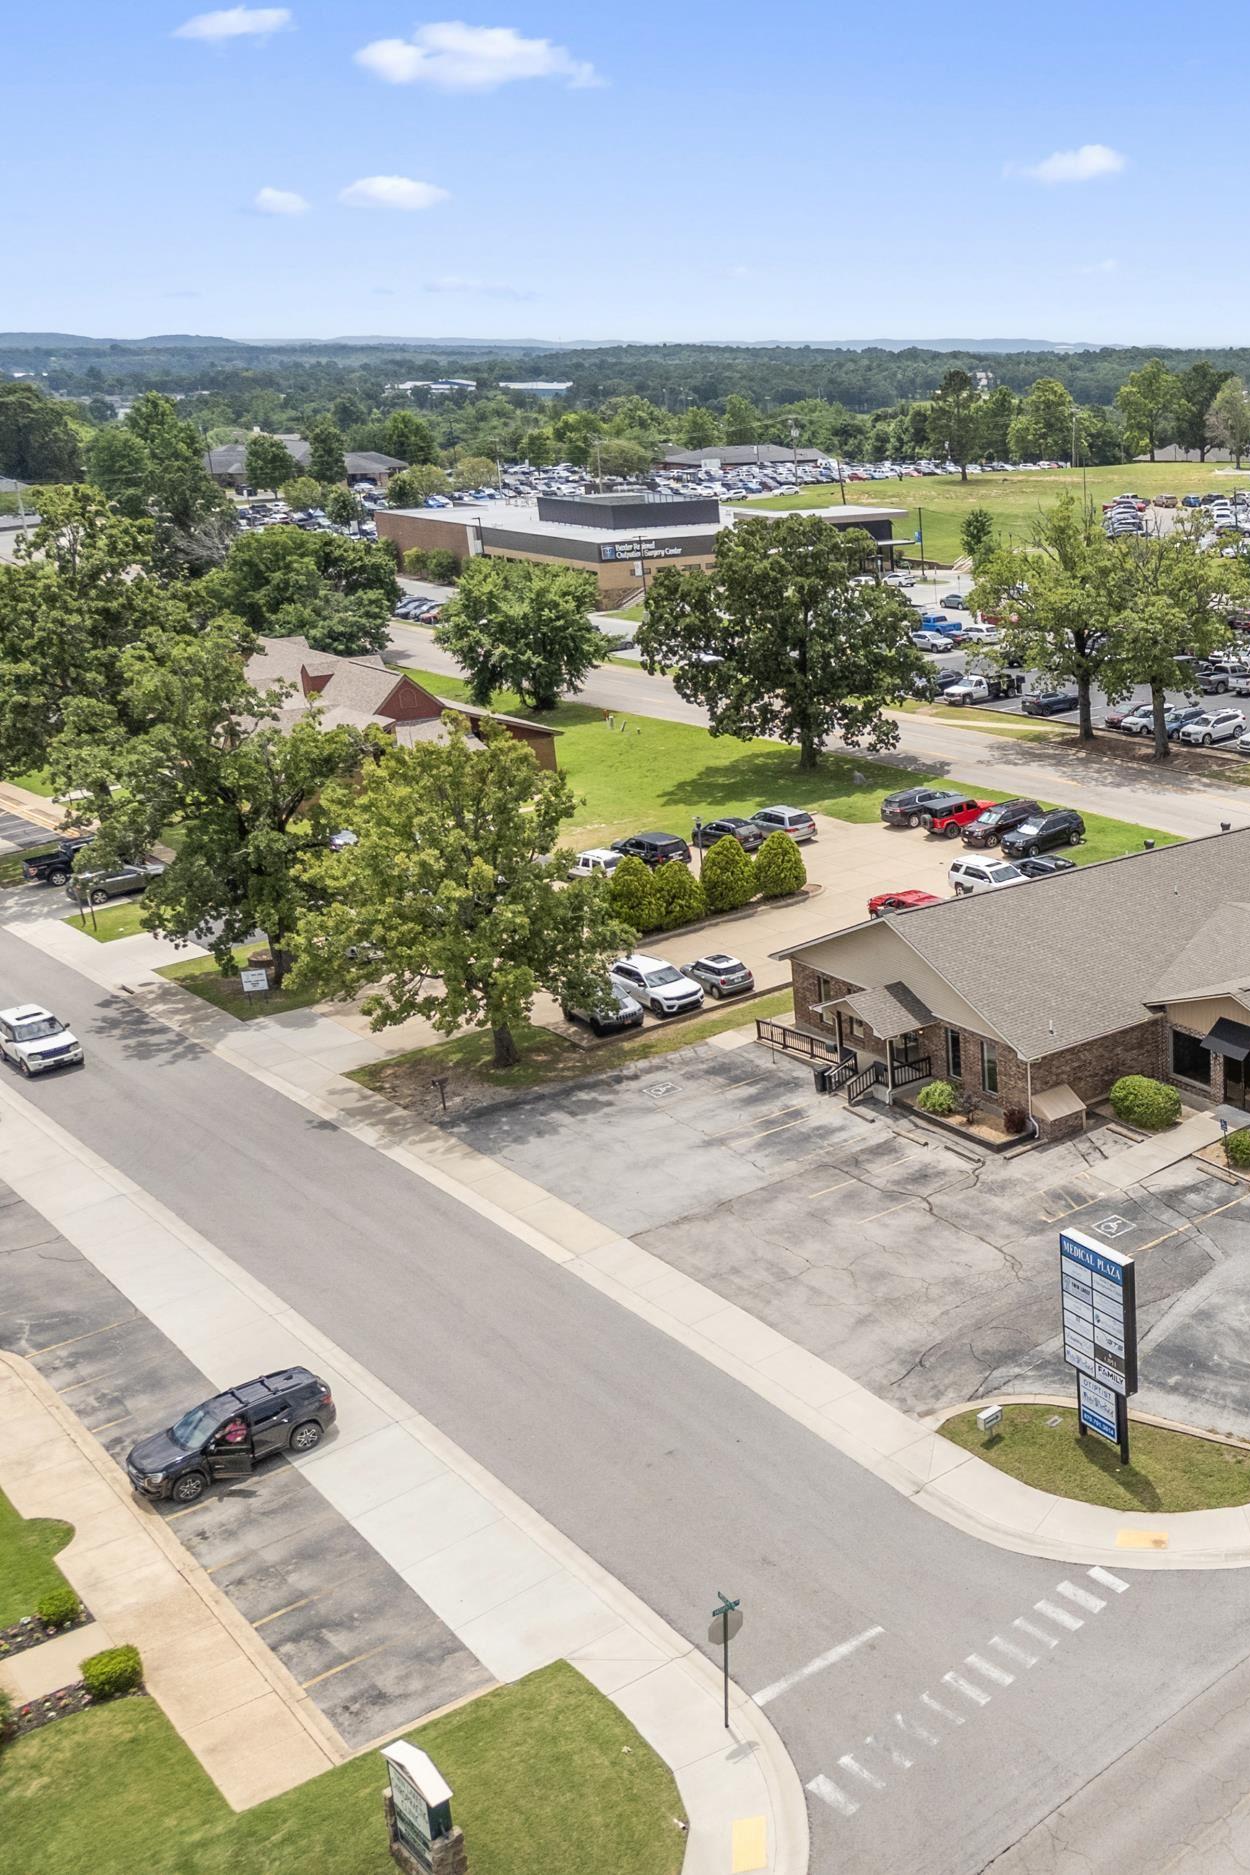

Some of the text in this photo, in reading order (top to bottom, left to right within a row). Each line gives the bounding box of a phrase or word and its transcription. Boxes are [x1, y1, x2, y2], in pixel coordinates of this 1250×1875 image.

[644, 549, 665, 558] Surgery
[665, 547, 682, 555] Center
[1063, 1241, 1095, 1266] MEDICAL
[1097, 1258, 1121, 1280] PLAZA
[1097, 1365, 1124, 1385] FAMILY
